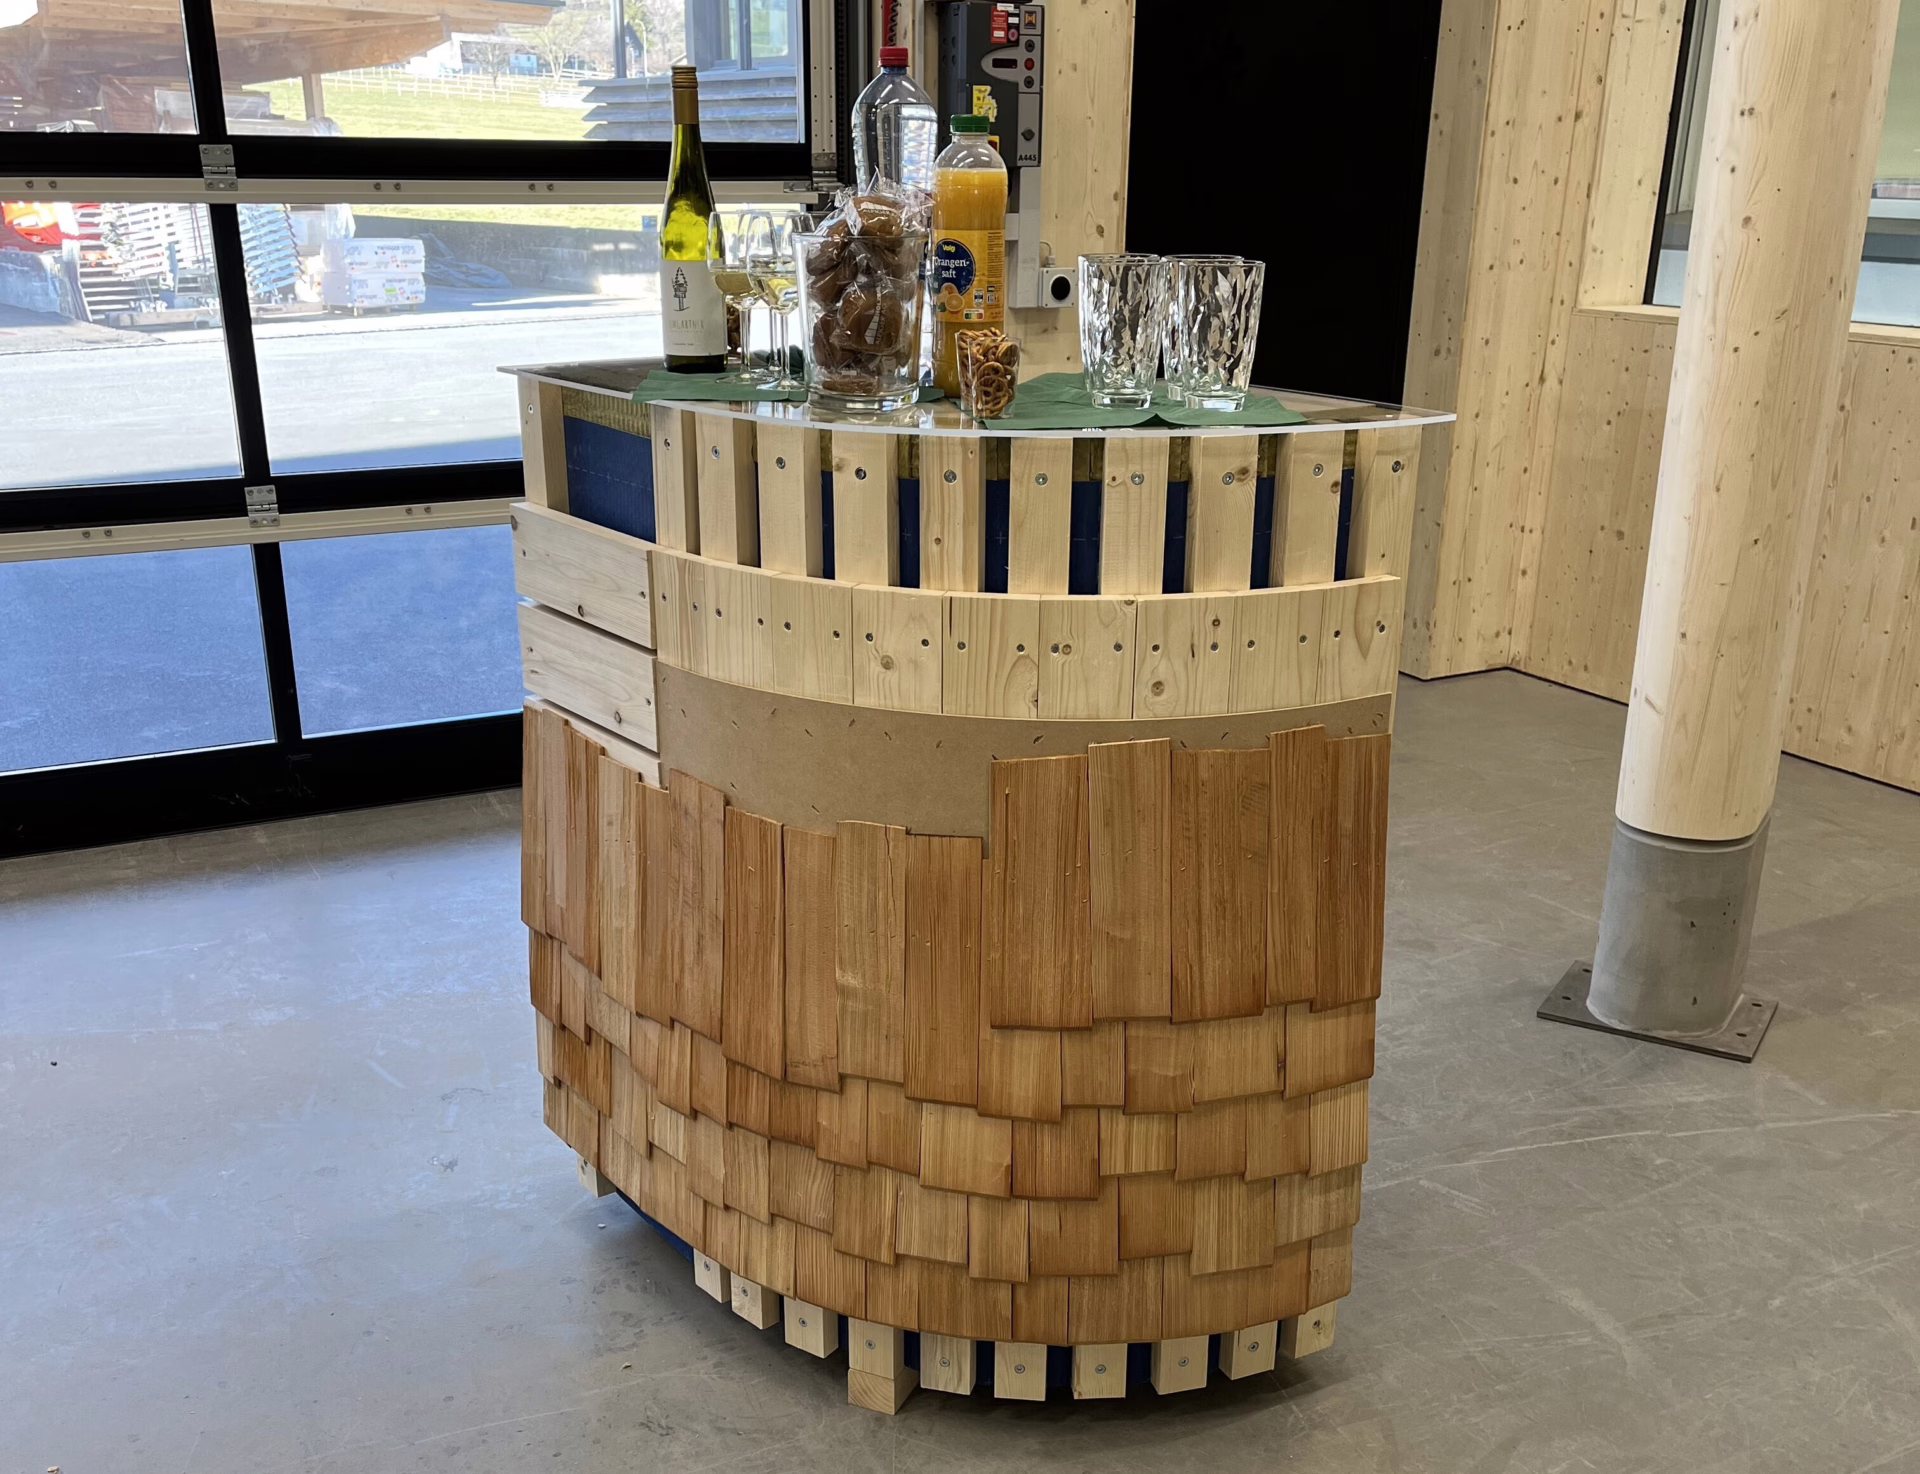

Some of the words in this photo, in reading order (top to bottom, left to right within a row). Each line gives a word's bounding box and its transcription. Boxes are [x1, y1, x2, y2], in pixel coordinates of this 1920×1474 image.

[1018, 153, 1037, 161] A445
[942, 244, 956, 253] Volg
[934, 256, 970, 268] Orangen-
[941, 268, 957, 278] saft
